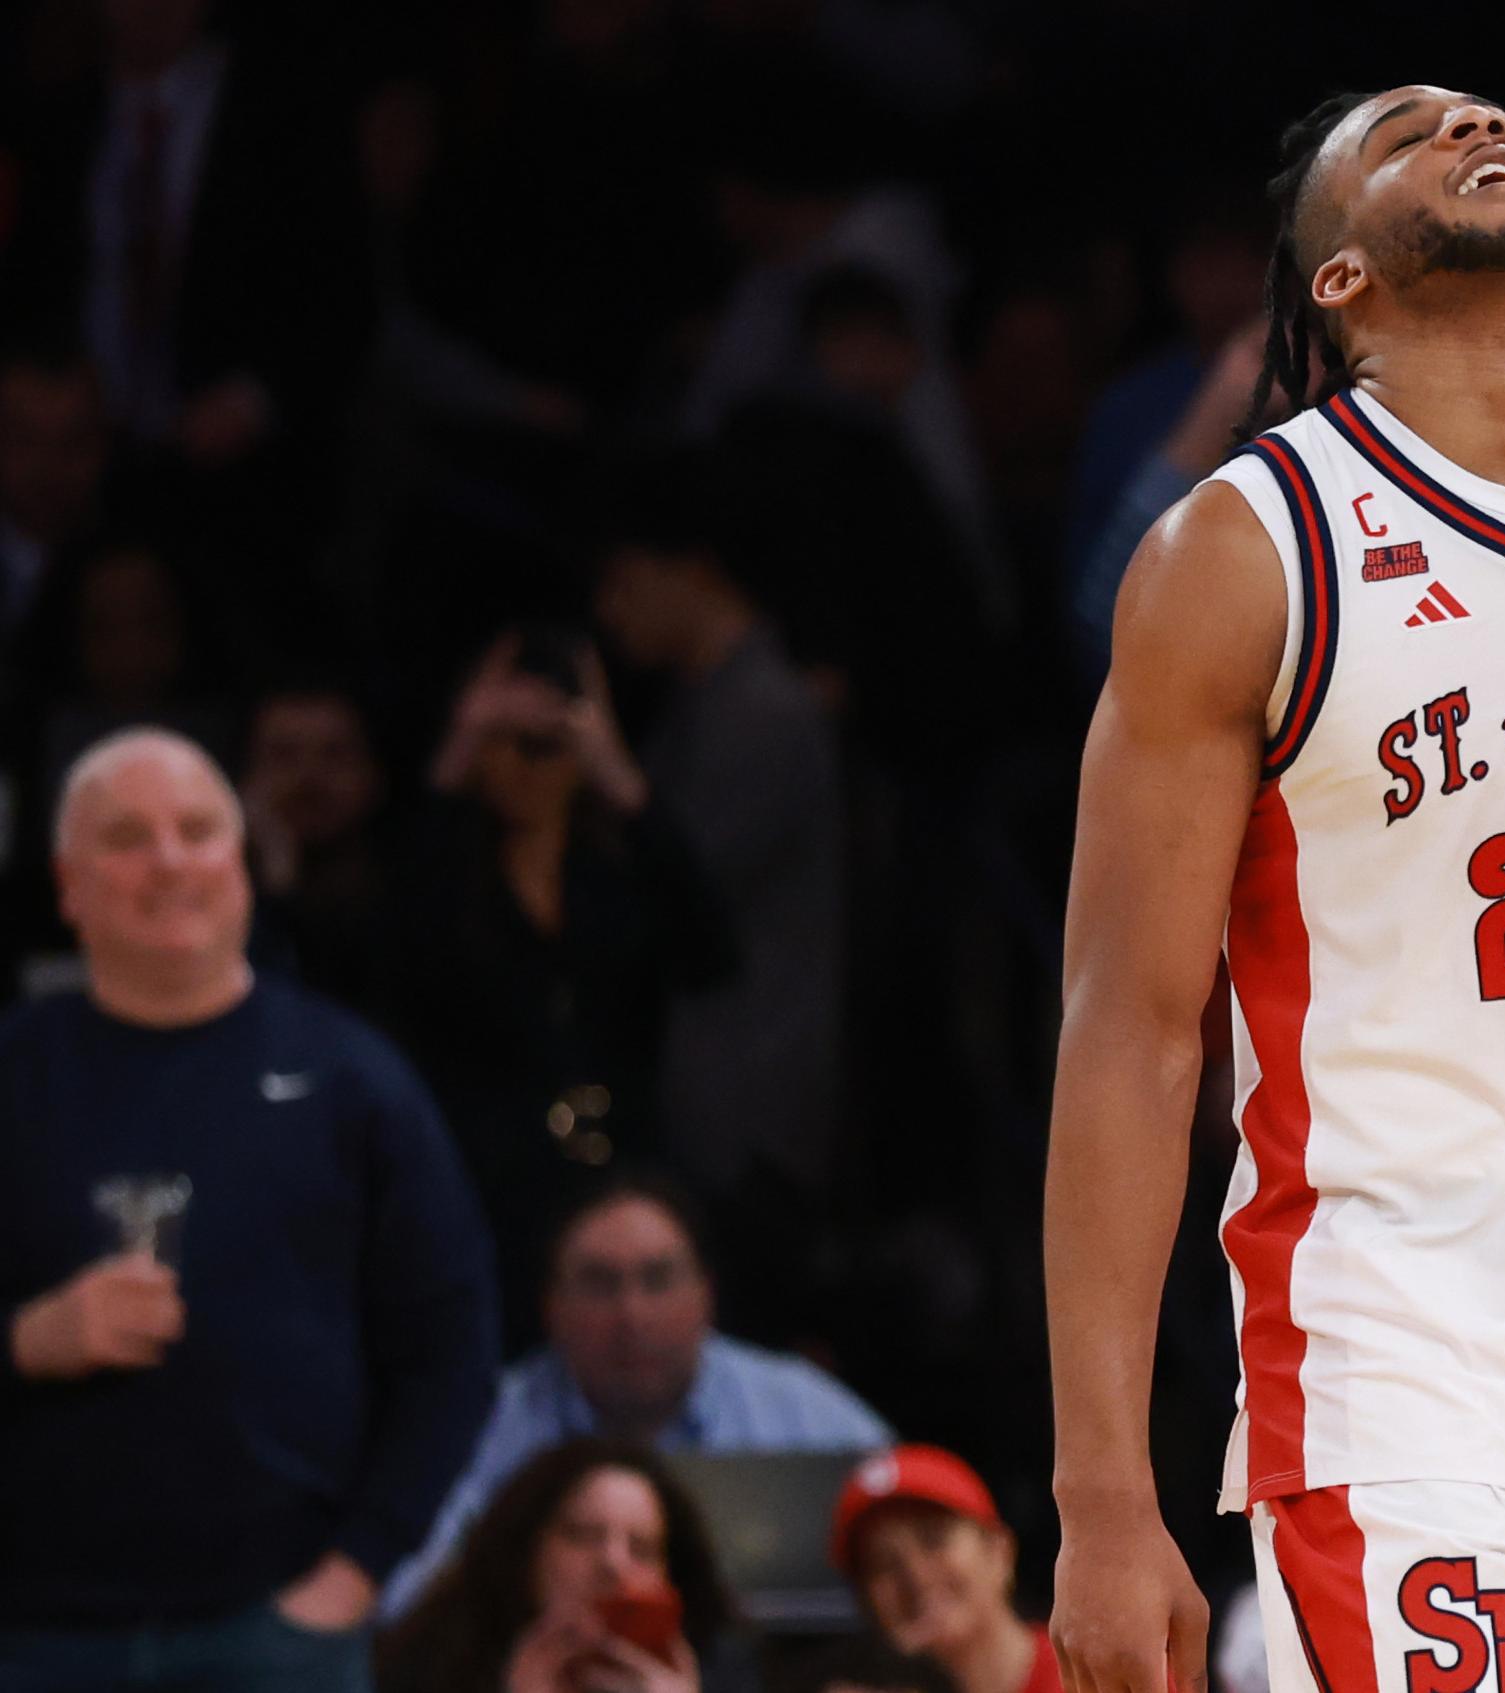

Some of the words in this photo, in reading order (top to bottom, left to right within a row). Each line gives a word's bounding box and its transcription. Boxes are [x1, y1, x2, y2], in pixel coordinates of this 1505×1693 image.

[1352, 492, 1388, 537] C
[1363, 558, 1427, 581] CHANGE
[1366, 550, 1385, 565] BE
[1392, 543, 1421, 558] THE
[1378, 687, 1489, 827] ST.
